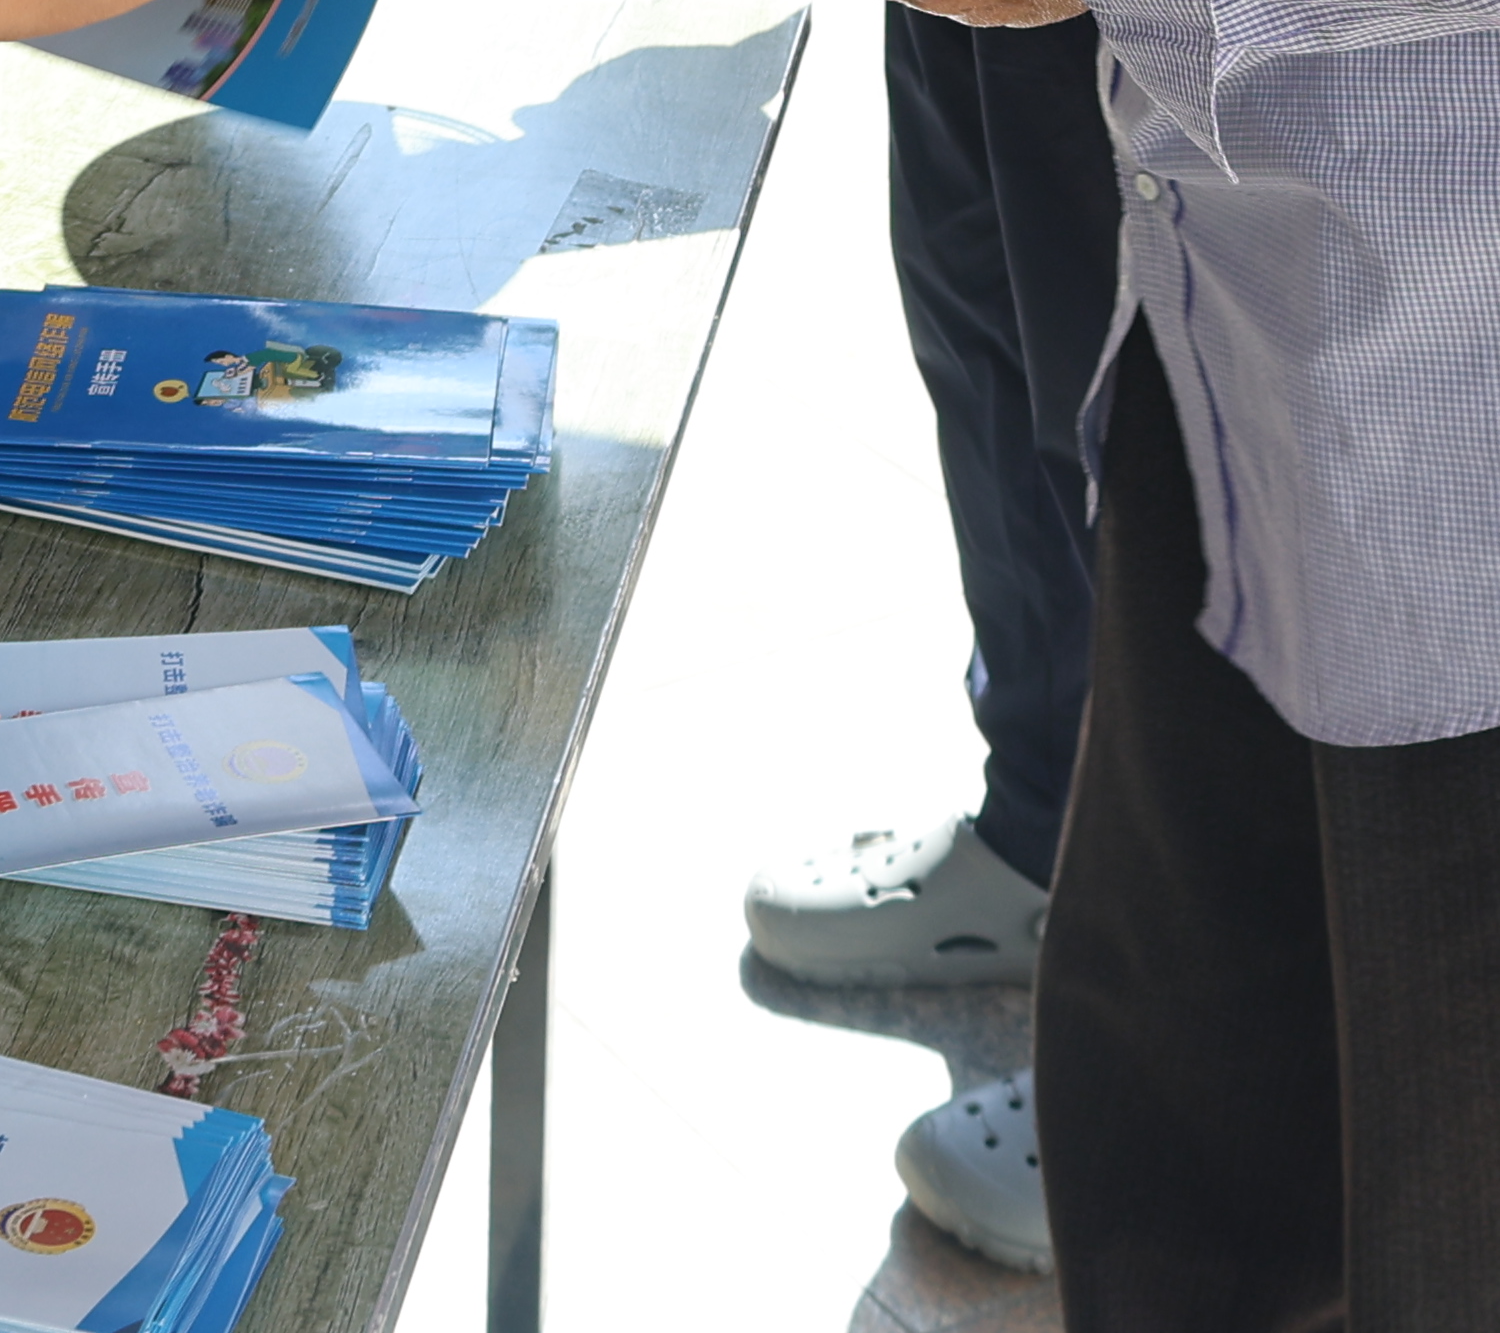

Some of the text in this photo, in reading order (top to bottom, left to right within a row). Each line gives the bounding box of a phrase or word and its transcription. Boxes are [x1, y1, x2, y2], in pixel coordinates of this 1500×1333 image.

[8, 313, 75, 422] 防范电信网络诈骗
[87, 348, 126, 397] 宣传手册
[149, 713, 238, 827] 打击整治养老诈骗
